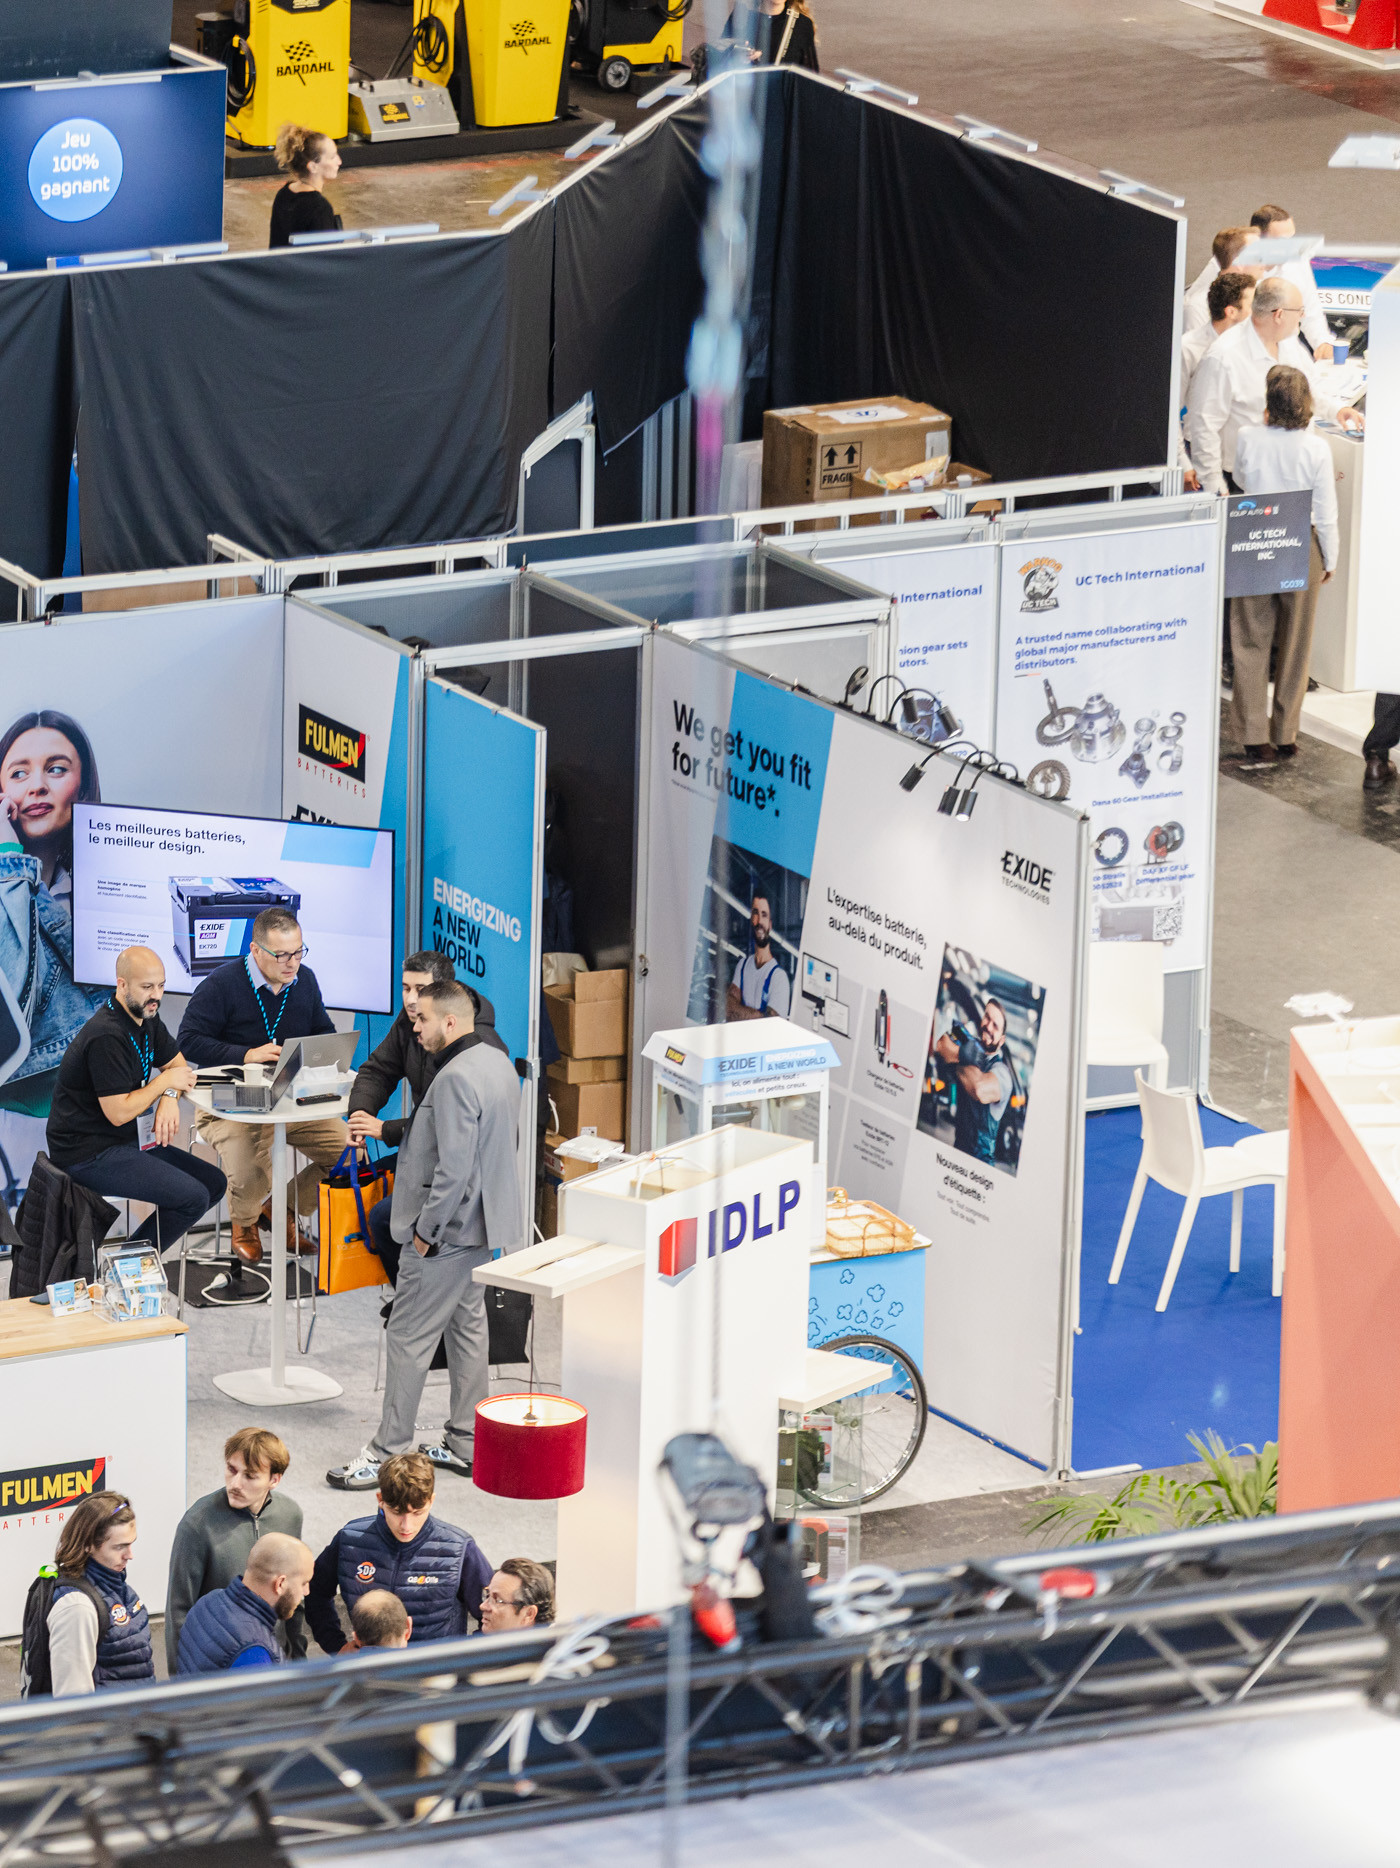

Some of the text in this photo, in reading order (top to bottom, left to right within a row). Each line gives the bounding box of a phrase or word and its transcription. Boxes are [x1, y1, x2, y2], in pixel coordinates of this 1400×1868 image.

[504, 36, 552, 49] BARDAHL
[276, 61, 335, 78] BARDAHL
[61, 131, 91, 149] Jeu
[52, 153, 100, 173] 100%
[40, 176, 111, 201] gagnant
[822, 471, 853, 485] FRAGI
[1231, 537, 1303, 553] INTERNATIONAL,
[1248, 527, 1288, 540] UC TECH
[1257, 551, 1276, 561] INC.
[1076, 562, 1206, 587] UC Tech International
[900, 584, 983, 604] International
[1015, 617, 1188, 646] A trusted name collaborating with
[922, 640, 968, 656] gear sets
[1015, 630, 1177, 660] global major manufacturers and
[1014, 656, 1078, 671] distributors.
[305, 718, 359, 769] FULMEN
[673, 699, 812, 790] We get you fit
[671, 741, 699, 780] for
[297, 757, 366, 799] BATTERIES
[88, 818, 247, 845] Les meilleures batteries,
[88, 832, 206, 855] le meilleur design.
[1000, 850, 1054, 893] EXIDE
[1001, 875, 1051, 906] TECHNOLOGIES
[433, 876, 522, 943] ENERGIZING
[827, 886, 928, 950] L'expertise batterie,
[200, 923, 226, 931] EXIDE
[433, 905, 481, 949] A NEW
[433, 930, 486, 979] WORLD
[828, 914, 924, 972] au-delà du produit.
[718, 1056, 758, 1073] EXIDE
[767, 1063, 774, 1072] A
[774, 1060, 795, 1071] NEW
[794, 1056, 827, 1069] WORLD
[936, 1152, 994, 1191] Nouveau design
[943, 1175, 982, 1202] d'étiquette
[707, 1179, 801, 1259] IDLP
[2, 1469, 93, 1508] FULMEN
[357, 1564, 376, 1577] SDP
